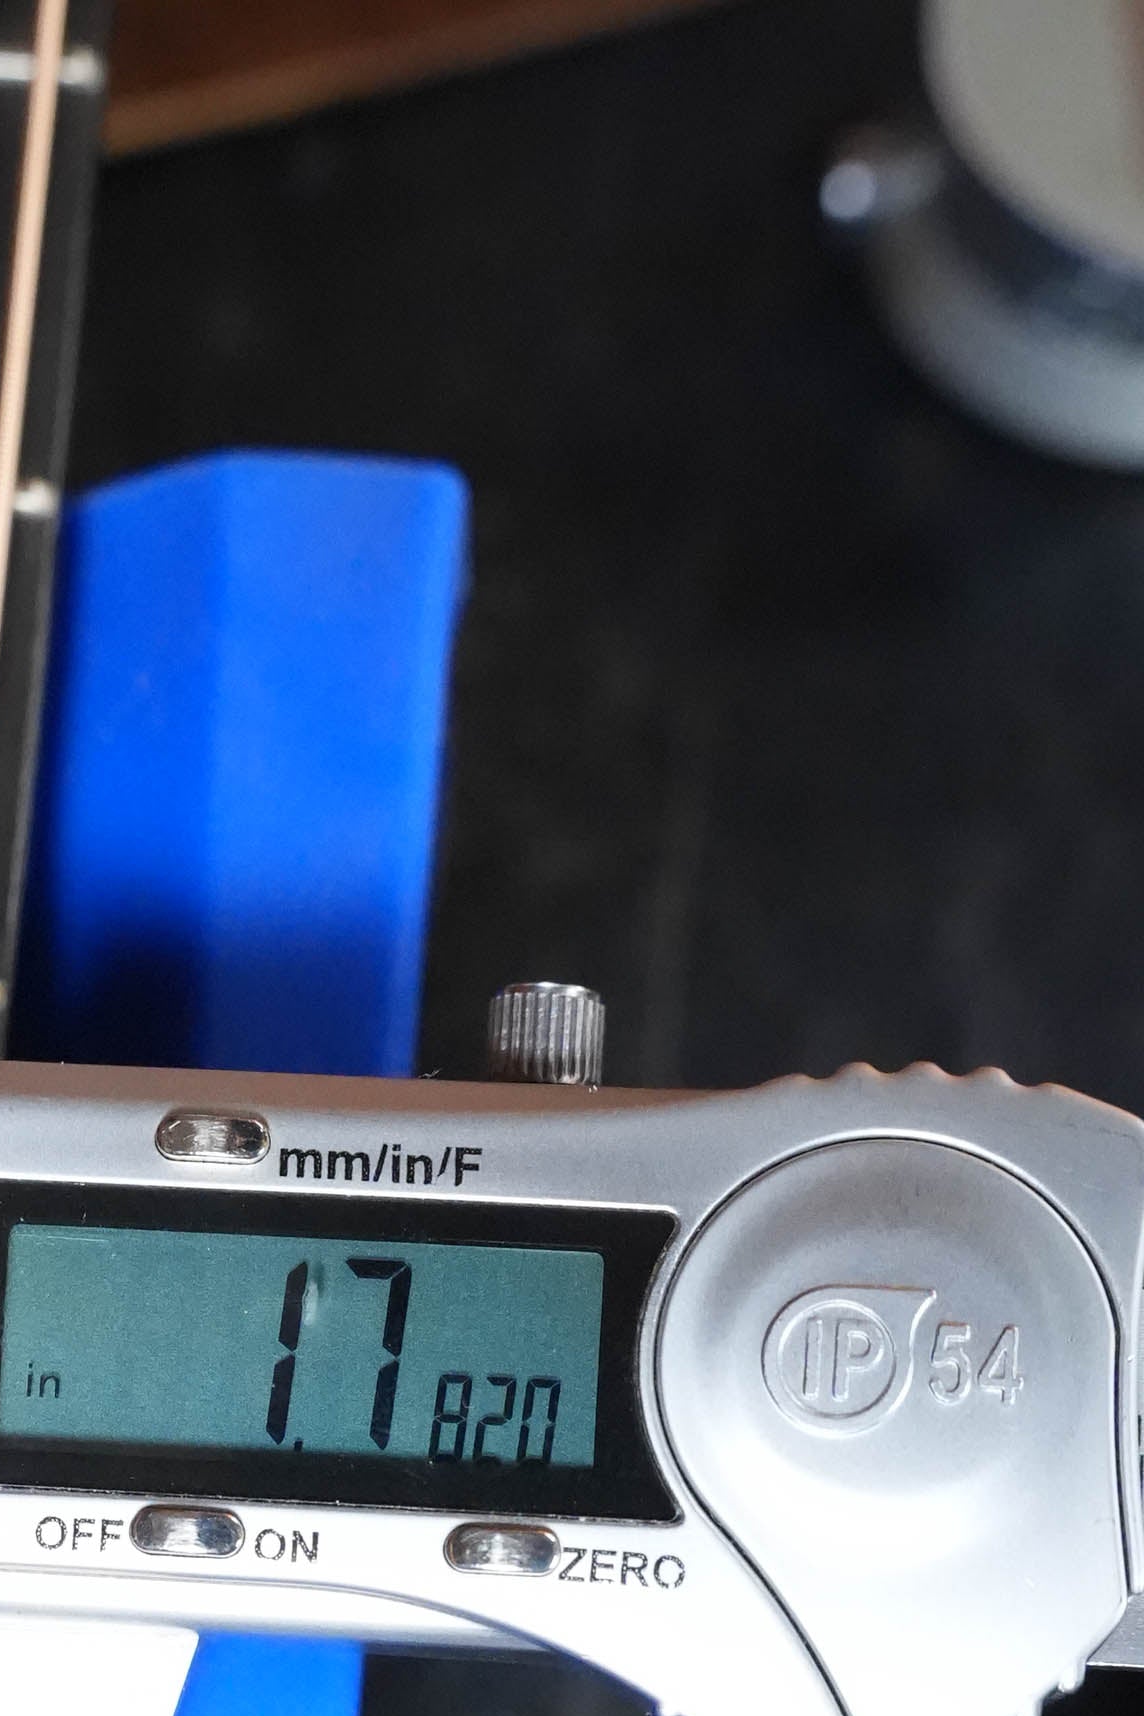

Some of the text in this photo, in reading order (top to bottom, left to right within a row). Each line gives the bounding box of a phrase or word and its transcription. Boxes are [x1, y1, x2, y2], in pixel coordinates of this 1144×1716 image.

[278, 1143, 483, 1188] mm/in/F
[25, 1363, 61, 1399] in
[928, 1320, 1024, 1406] 54
[35, 1516, 321, 1564] OFF ON
[558, 1546, 687, 1590] ZERO
